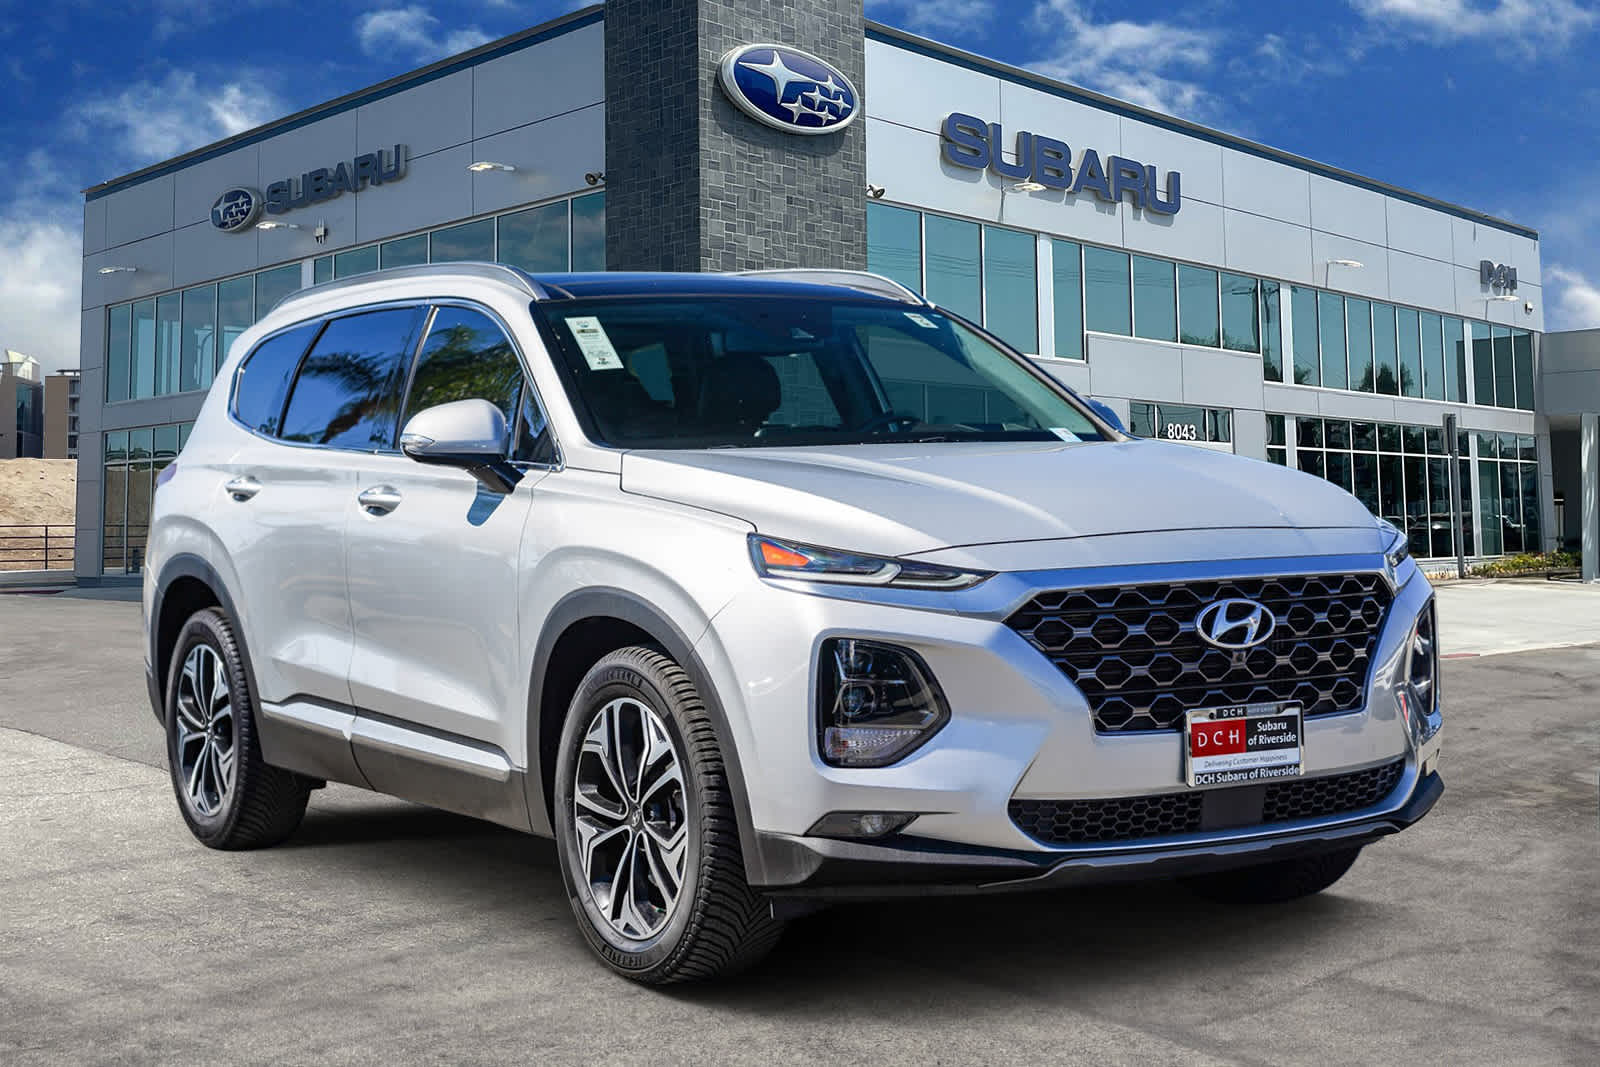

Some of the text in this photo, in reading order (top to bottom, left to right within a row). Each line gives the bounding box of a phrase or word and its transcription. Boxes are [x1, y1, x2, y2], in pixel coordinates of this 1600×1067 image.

[940, 112, 1182, 216] SUBARU
[266, 143, 408, 215] SUBARU
[1168, 423, 1196, 440] 8043
[1223, 707, 1244, 717] DCH
[1257, 720, 1287, 732] Subaru
[1197, 729, 1240, 747] DCH
[1248, 732, 1297, 745] of Riverside
[1195, 765, 1300, 785] DCH Subaru of Riverside
